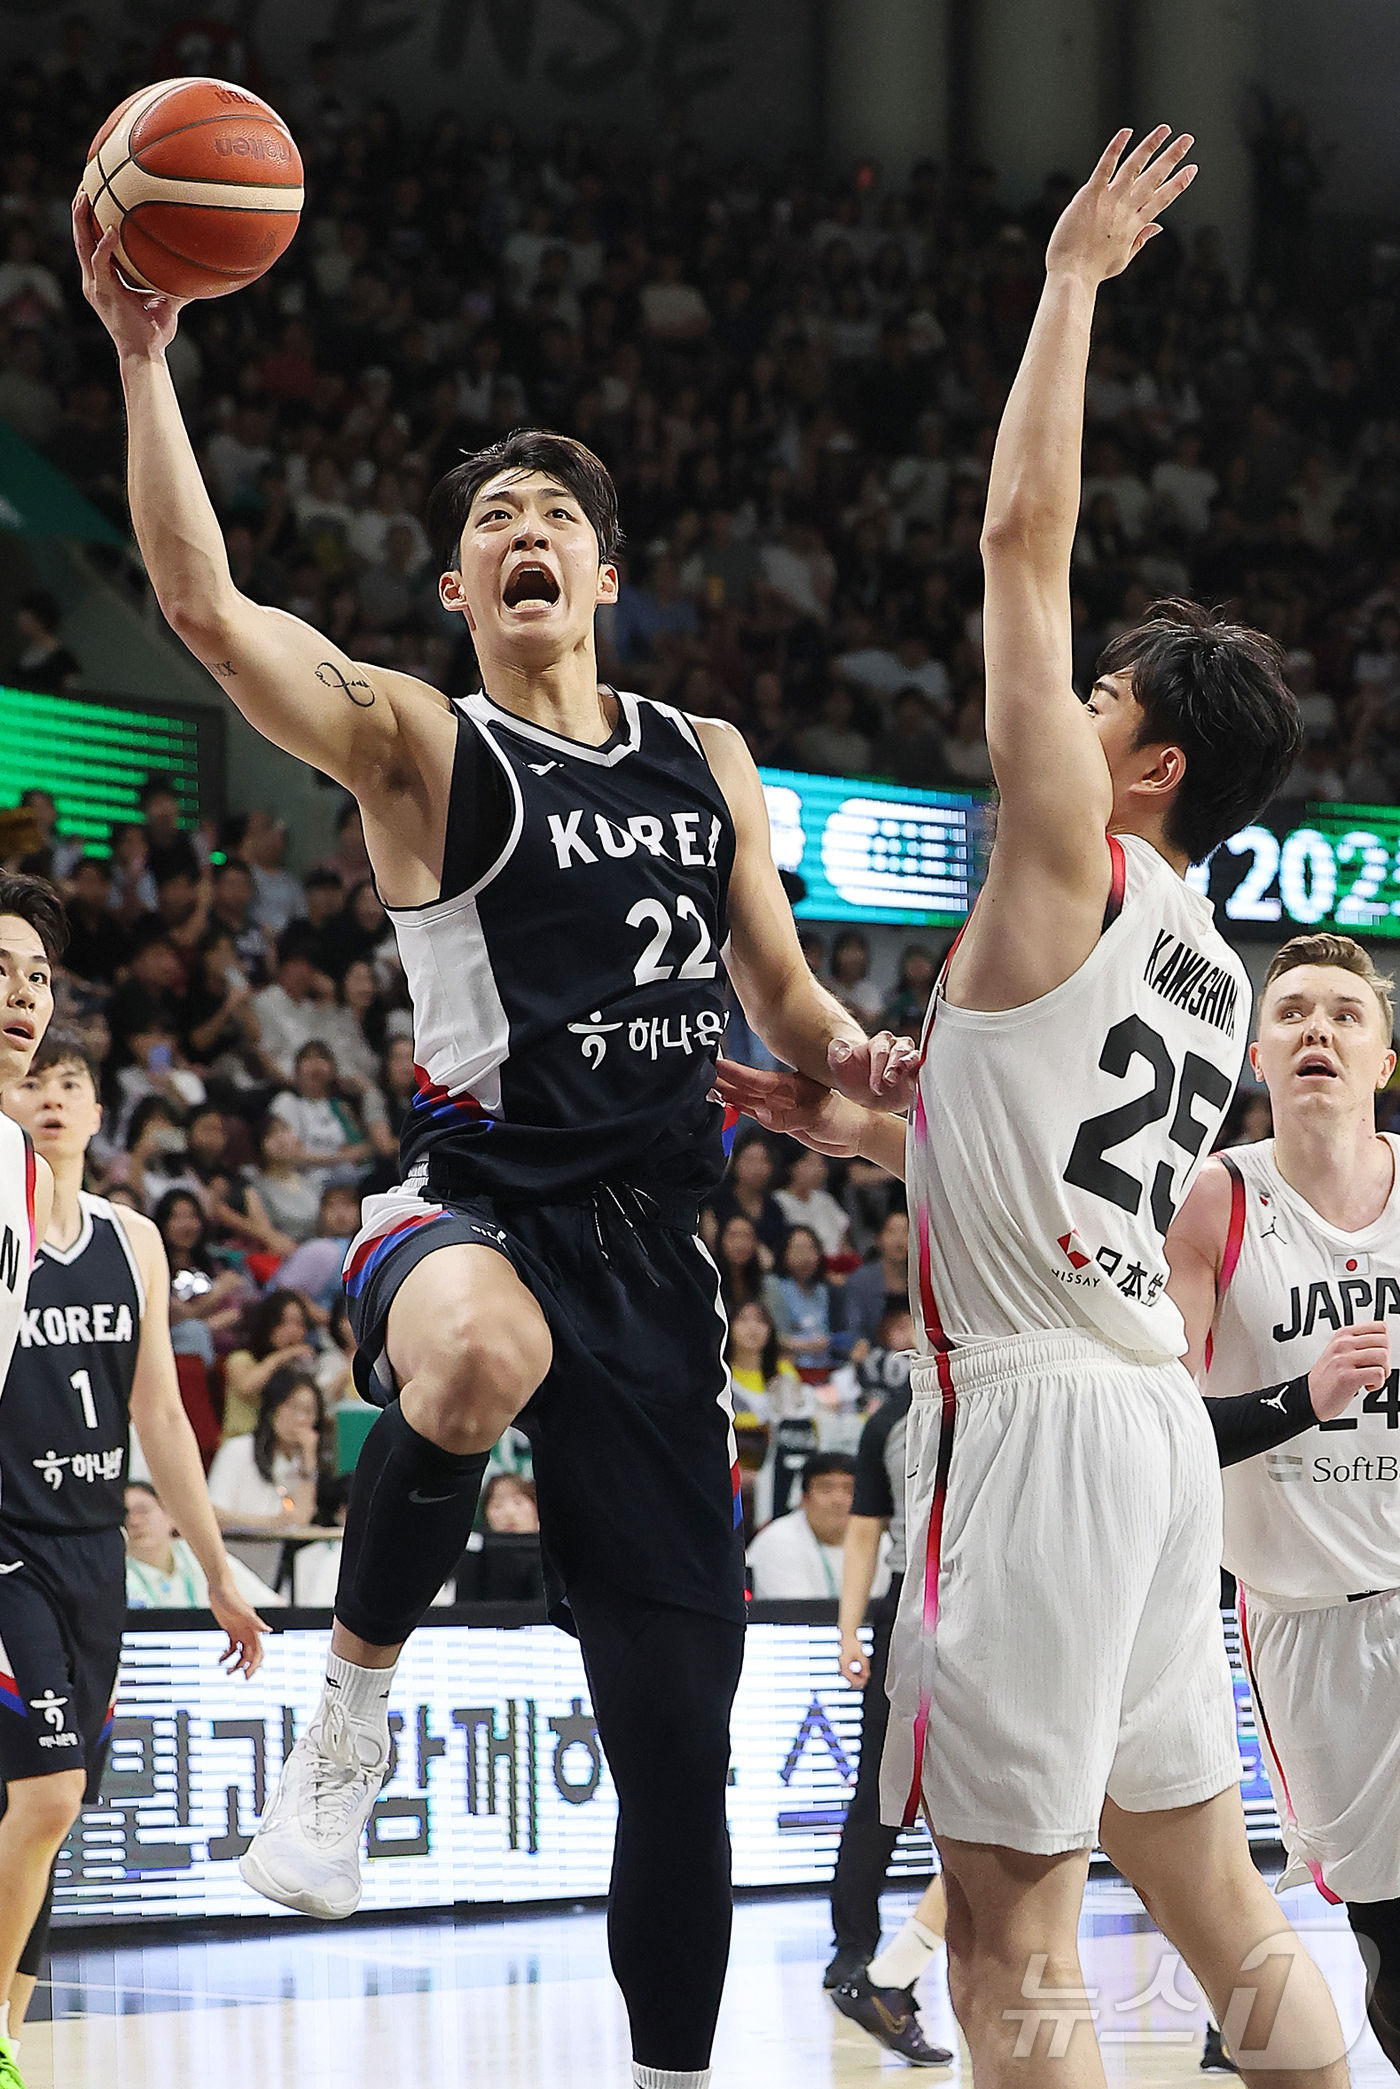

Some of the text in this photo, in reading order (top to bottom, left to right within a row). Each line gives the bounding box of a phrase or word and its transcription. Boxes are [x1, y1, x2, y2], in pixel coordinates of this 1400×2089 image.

[215, 137, 293, 162] molten
[1225, 825, 1400, 925] 202
[625, 894, 717, 987] 22
[628, 1009, 730, 1061] 하나은
[1062, 1013, 1233, 1237] 25
[20, 1303, 133, 1349] KOREA
[1272, 1277, 1400, 1343] JAPA
[69, 1369, 98, 1429] 1
[1319, 1368, 1400, 1431] 4
[1312, 1456, 1400, 1483] SoftB
